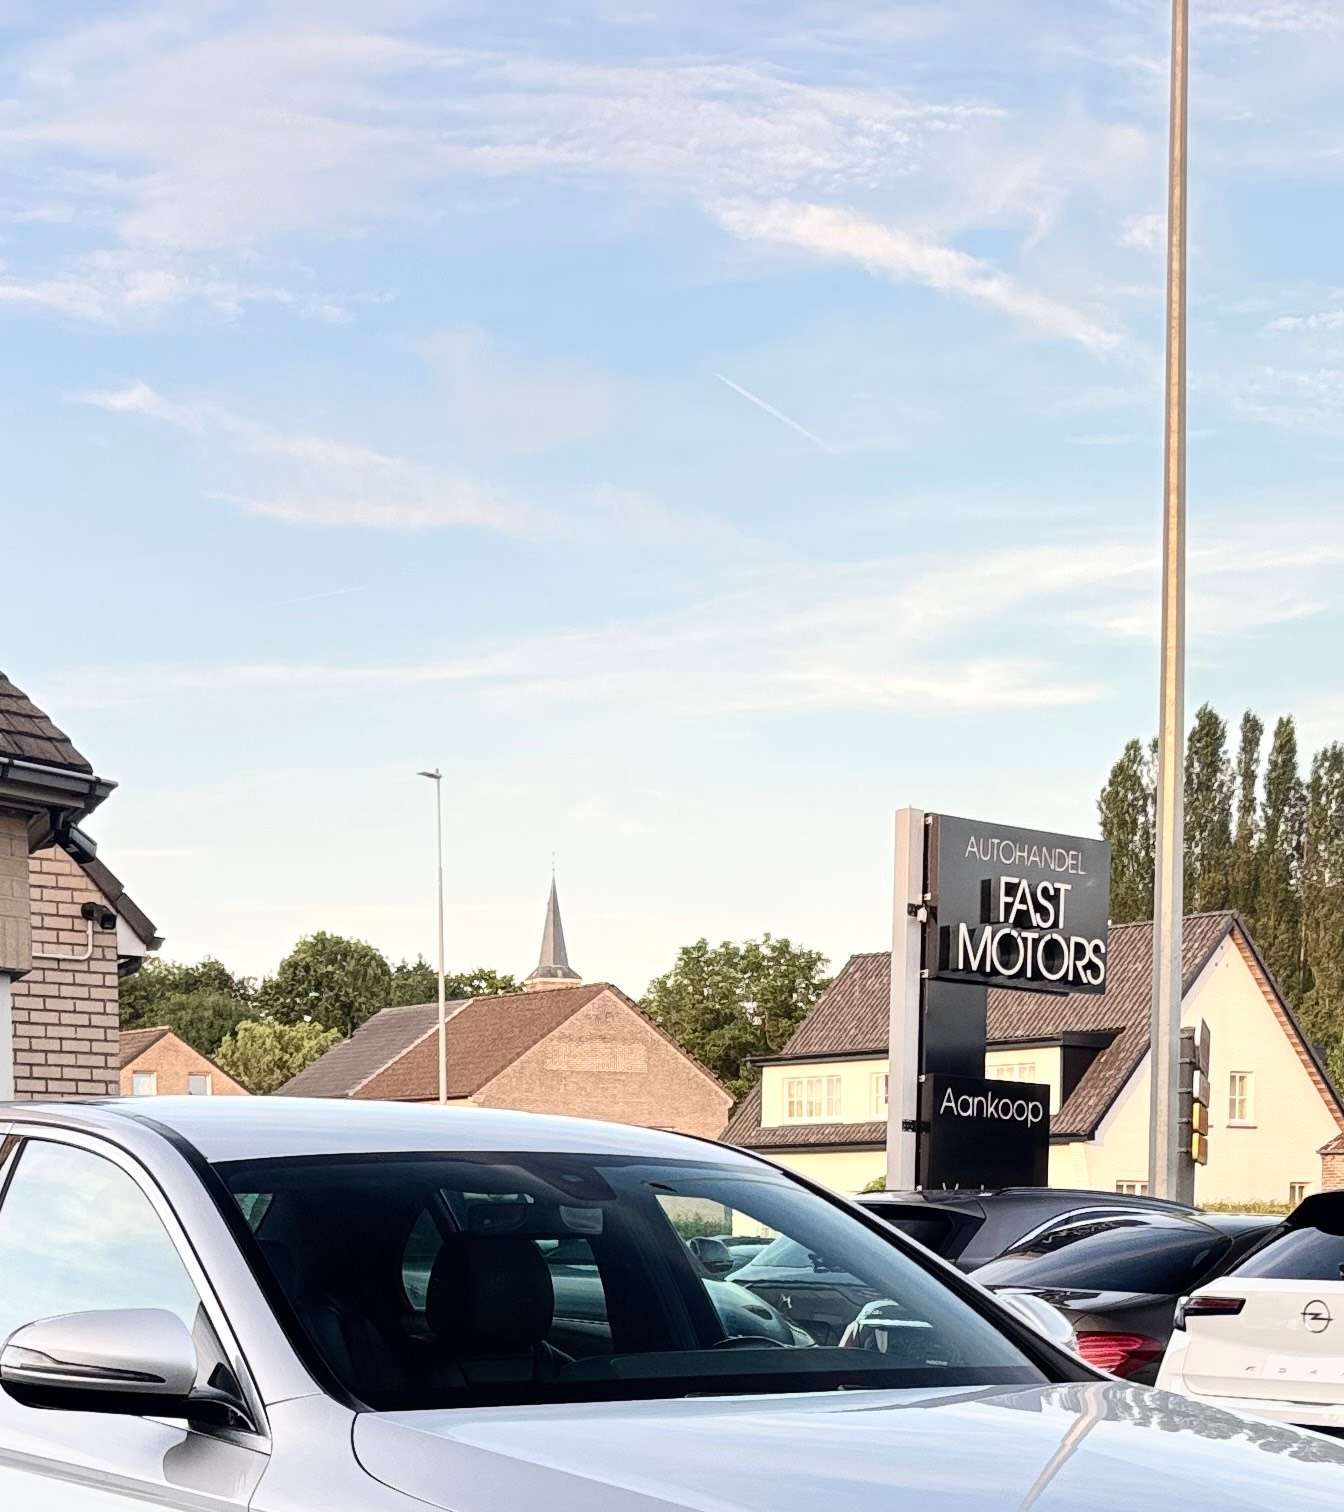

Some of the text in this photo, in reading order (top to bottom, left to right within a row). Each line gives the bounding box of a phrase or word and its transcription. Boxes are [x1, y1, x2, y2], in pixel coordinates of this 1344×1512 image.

[964, 835, 1088, 875] AUTOHANDEL
[998, 875, 1072, 930] FAST
[957, 922, 1106, 986] MOTORS
[939, 1087, 1044, 1128] Aankoop
